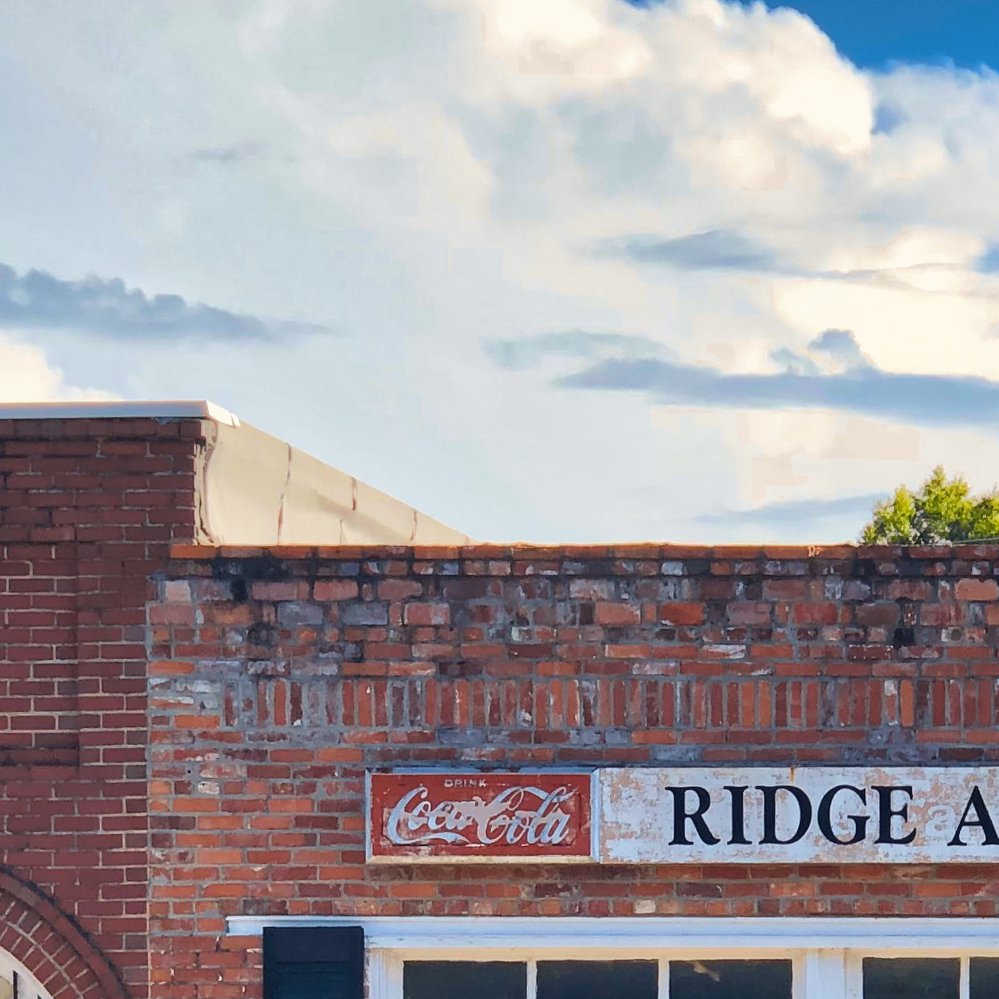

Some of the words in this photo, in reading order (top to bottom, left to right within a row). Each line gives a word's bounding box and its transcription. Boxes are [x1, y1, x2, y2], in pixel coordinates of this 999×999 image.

[443, 778, 487, 788] DRINK
[387, 786, 578, 845] Coca-Cola
[665, 784, 917, 847] RIDGE
